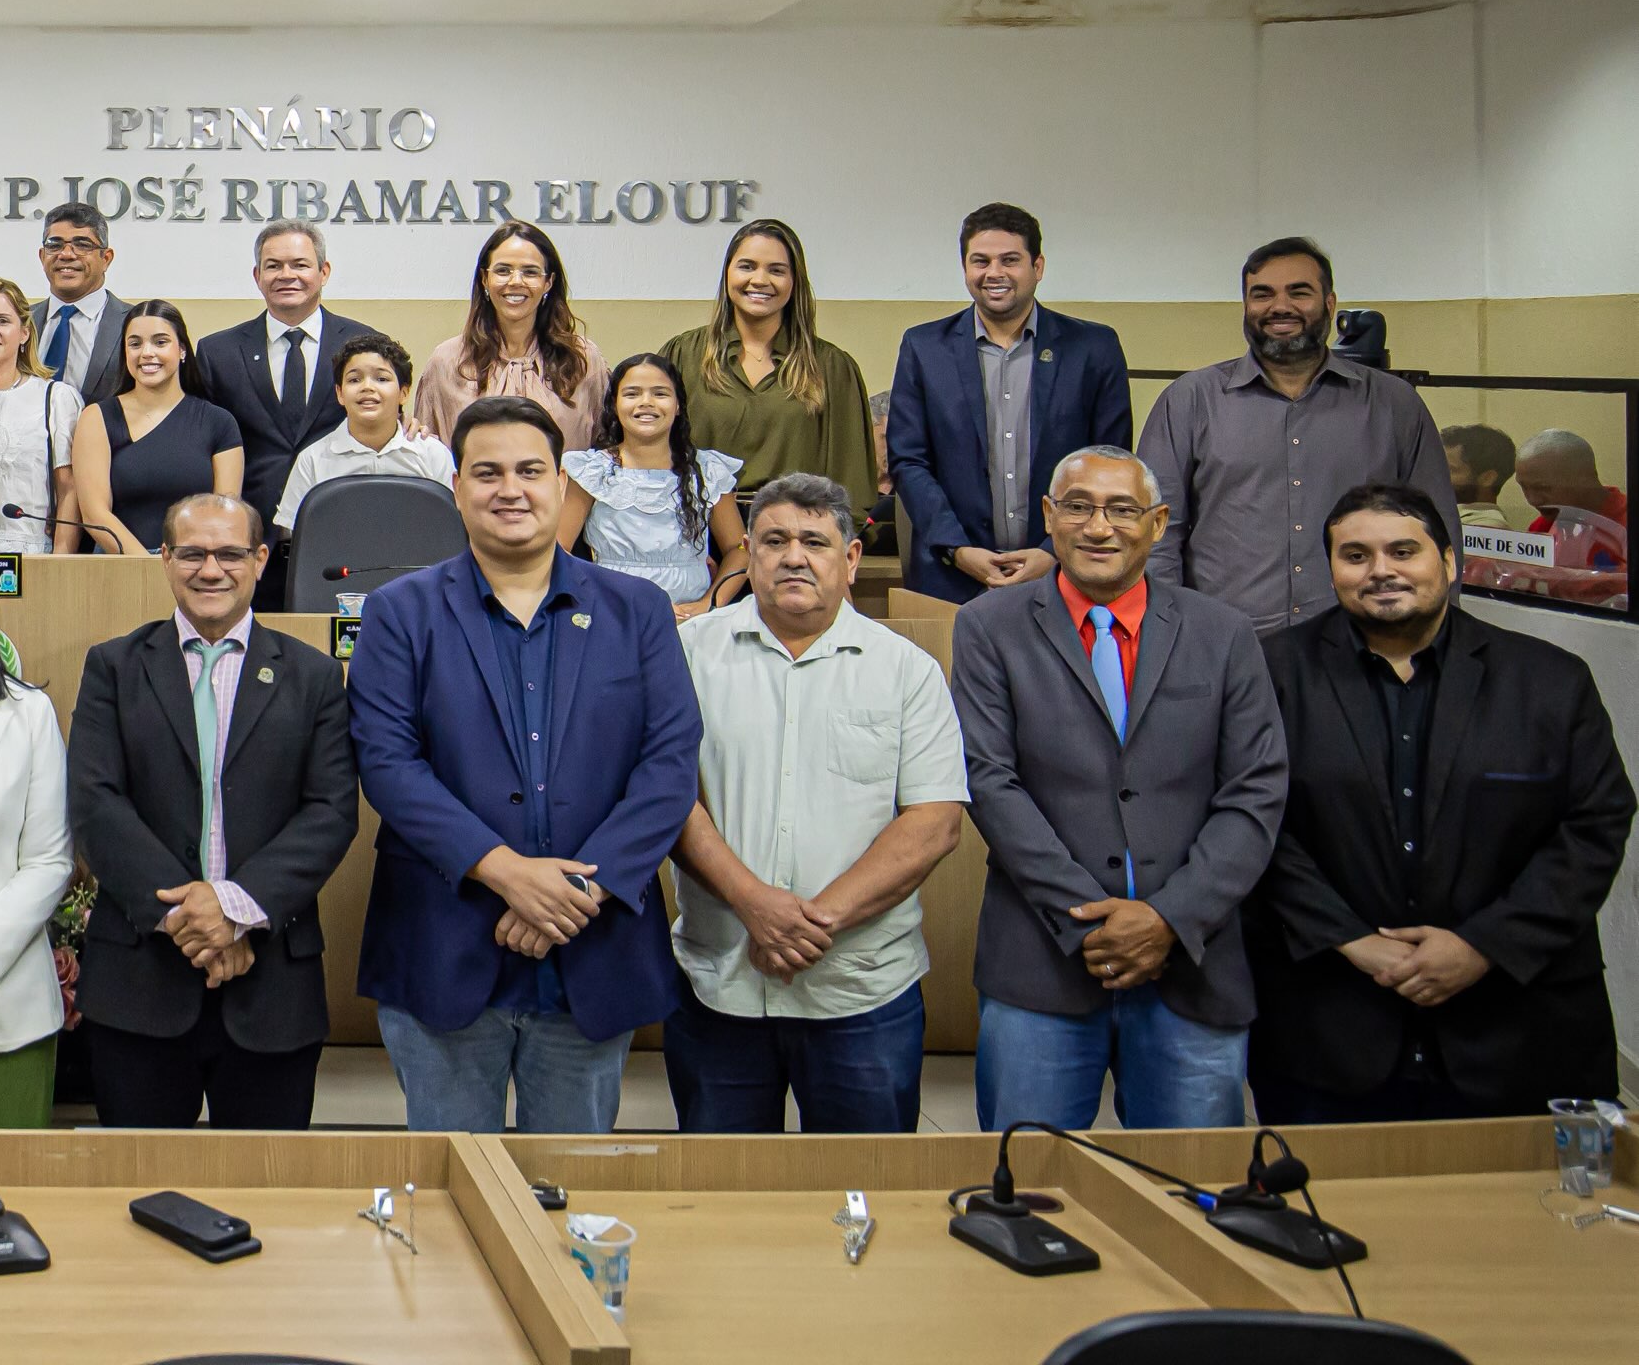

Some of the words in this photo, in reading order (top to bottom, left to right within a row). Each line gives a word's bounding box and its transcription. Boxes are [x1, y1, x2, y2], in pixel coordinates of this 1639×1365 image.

[106, 94, 437, 152] PLENÁRIO
[62, 163, 206, 221] JOSÉ
[220, 178, 519, 224] RIBAMAR
[534, 179, 759, 224] ELOUF
[1464, 535, 1492, 551] BINE
[1496, 539, 1513, 554] DE
[1517, 542, 1545, 558] SOM
